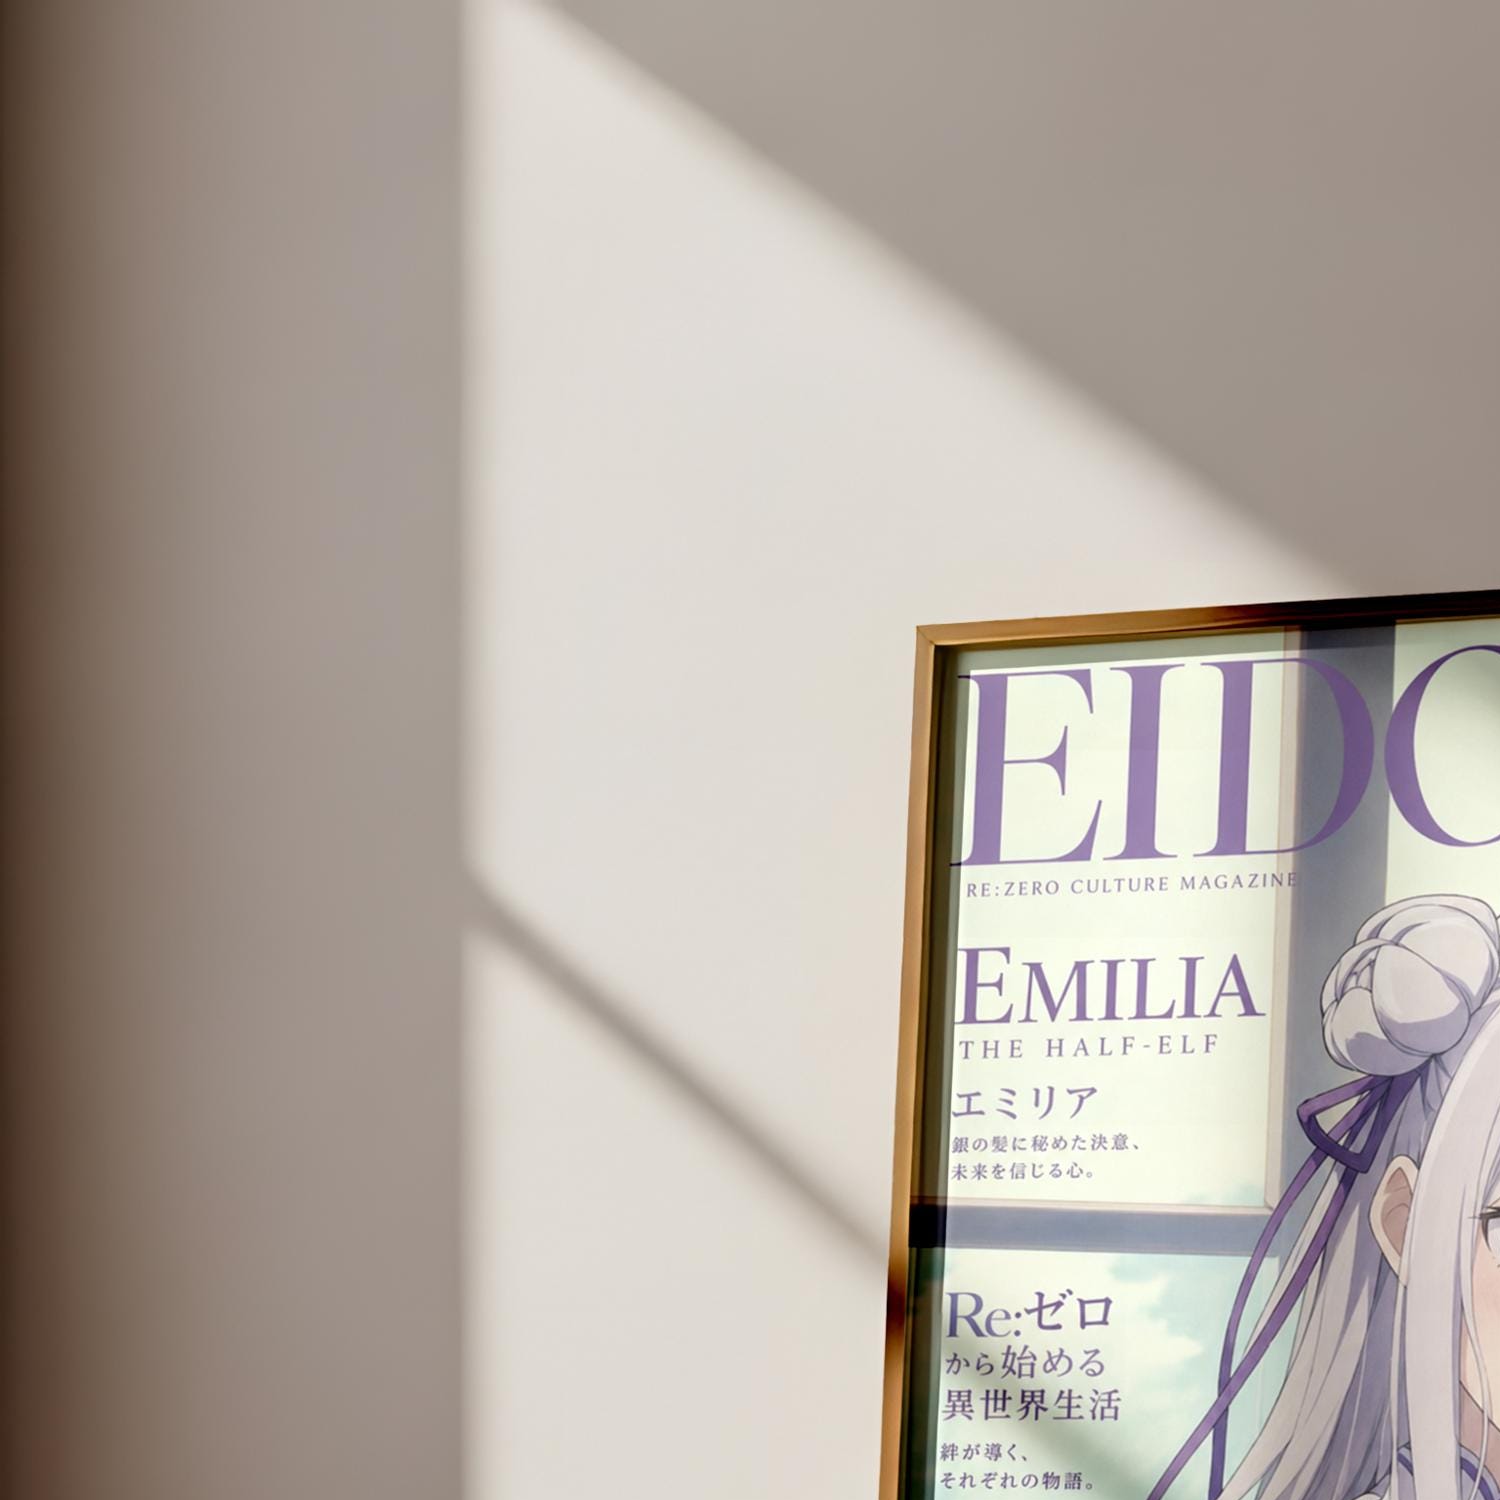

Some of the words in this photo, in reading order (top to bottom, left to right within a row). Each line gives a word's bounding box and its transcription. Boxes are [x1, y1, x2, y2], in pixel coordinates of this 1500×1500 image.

[965, 879, 1061, 899] RE:ZERO
[1070, 876, 1170, 896] CULTURE
[1179, 872, 1299, 893] MAGAZINE
[953, 946, 1266, 1026] EMILIA
[958, 1038, 1024, 1060] THE
[1045, 1033, 1220, 1058] HALF-ELF
[950, 1085, 1099, 1121] エミリア
[950, 1133, 1141, 1155] 銀の髪に秘めた決意、
[950, 1162, 1095, 1182] 未来を信じる心。
[945, 1288, 1114, 1339] Re:ゼロ
[944, 1344, 1106, 1380] から始める
[941, 1388, 1122, 1423] 異世界生活
[939, 1442, 1029, 1463] 絆が導く、
[939, 1471, 1094, 1491] それぞれの物語。
